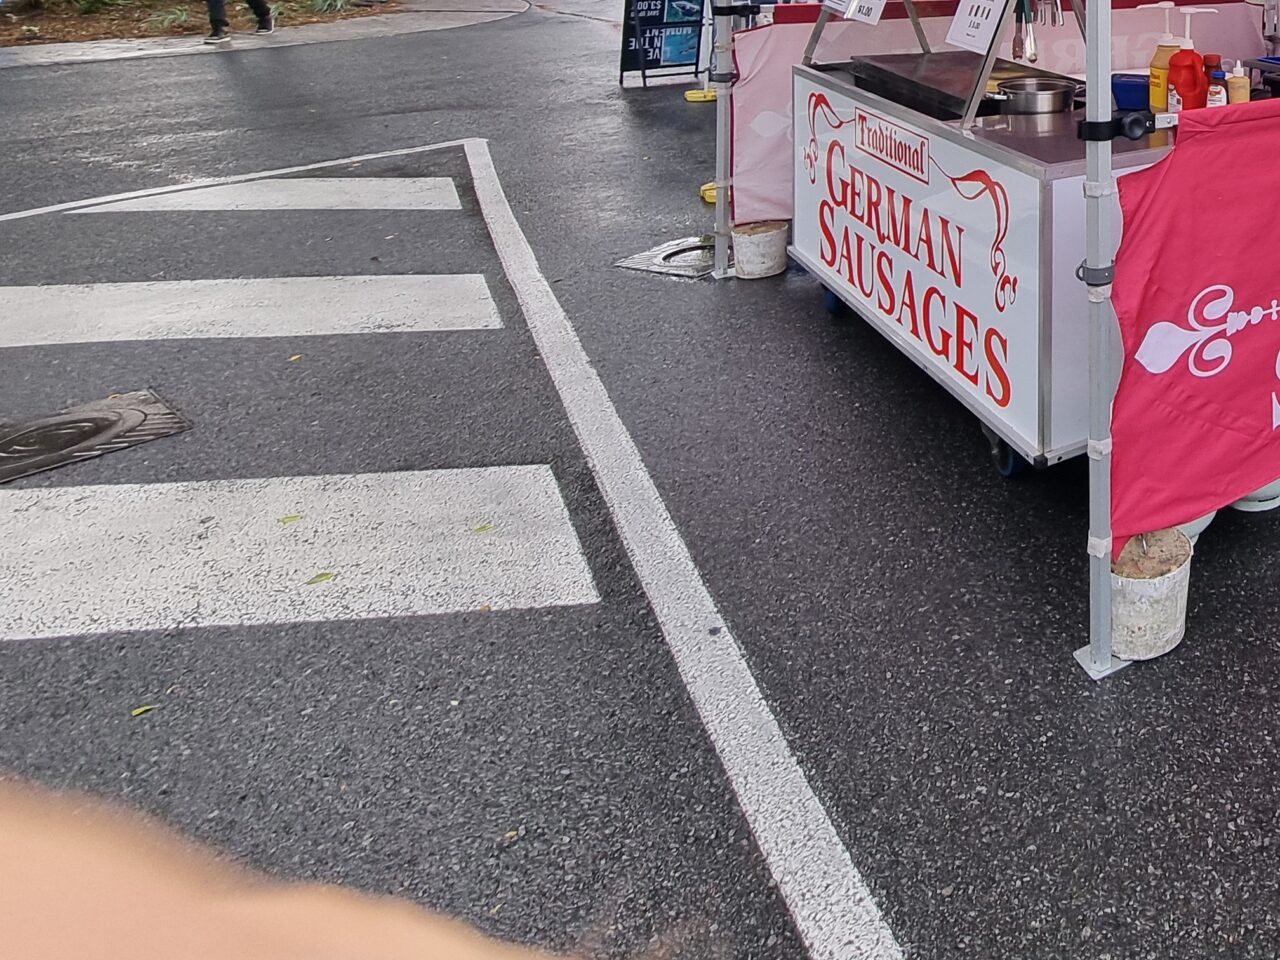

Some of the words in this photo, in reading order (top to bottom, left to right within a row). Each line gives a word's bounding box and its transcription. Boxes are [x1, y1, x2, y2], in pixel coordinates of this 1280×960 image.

[857, 5, 873, 17] $1.00
[858, 113, 926, 176] Traditional
[826, 139, 966, 289] GERMAN
[818, 198, 1012, 408] SAUSAGES
